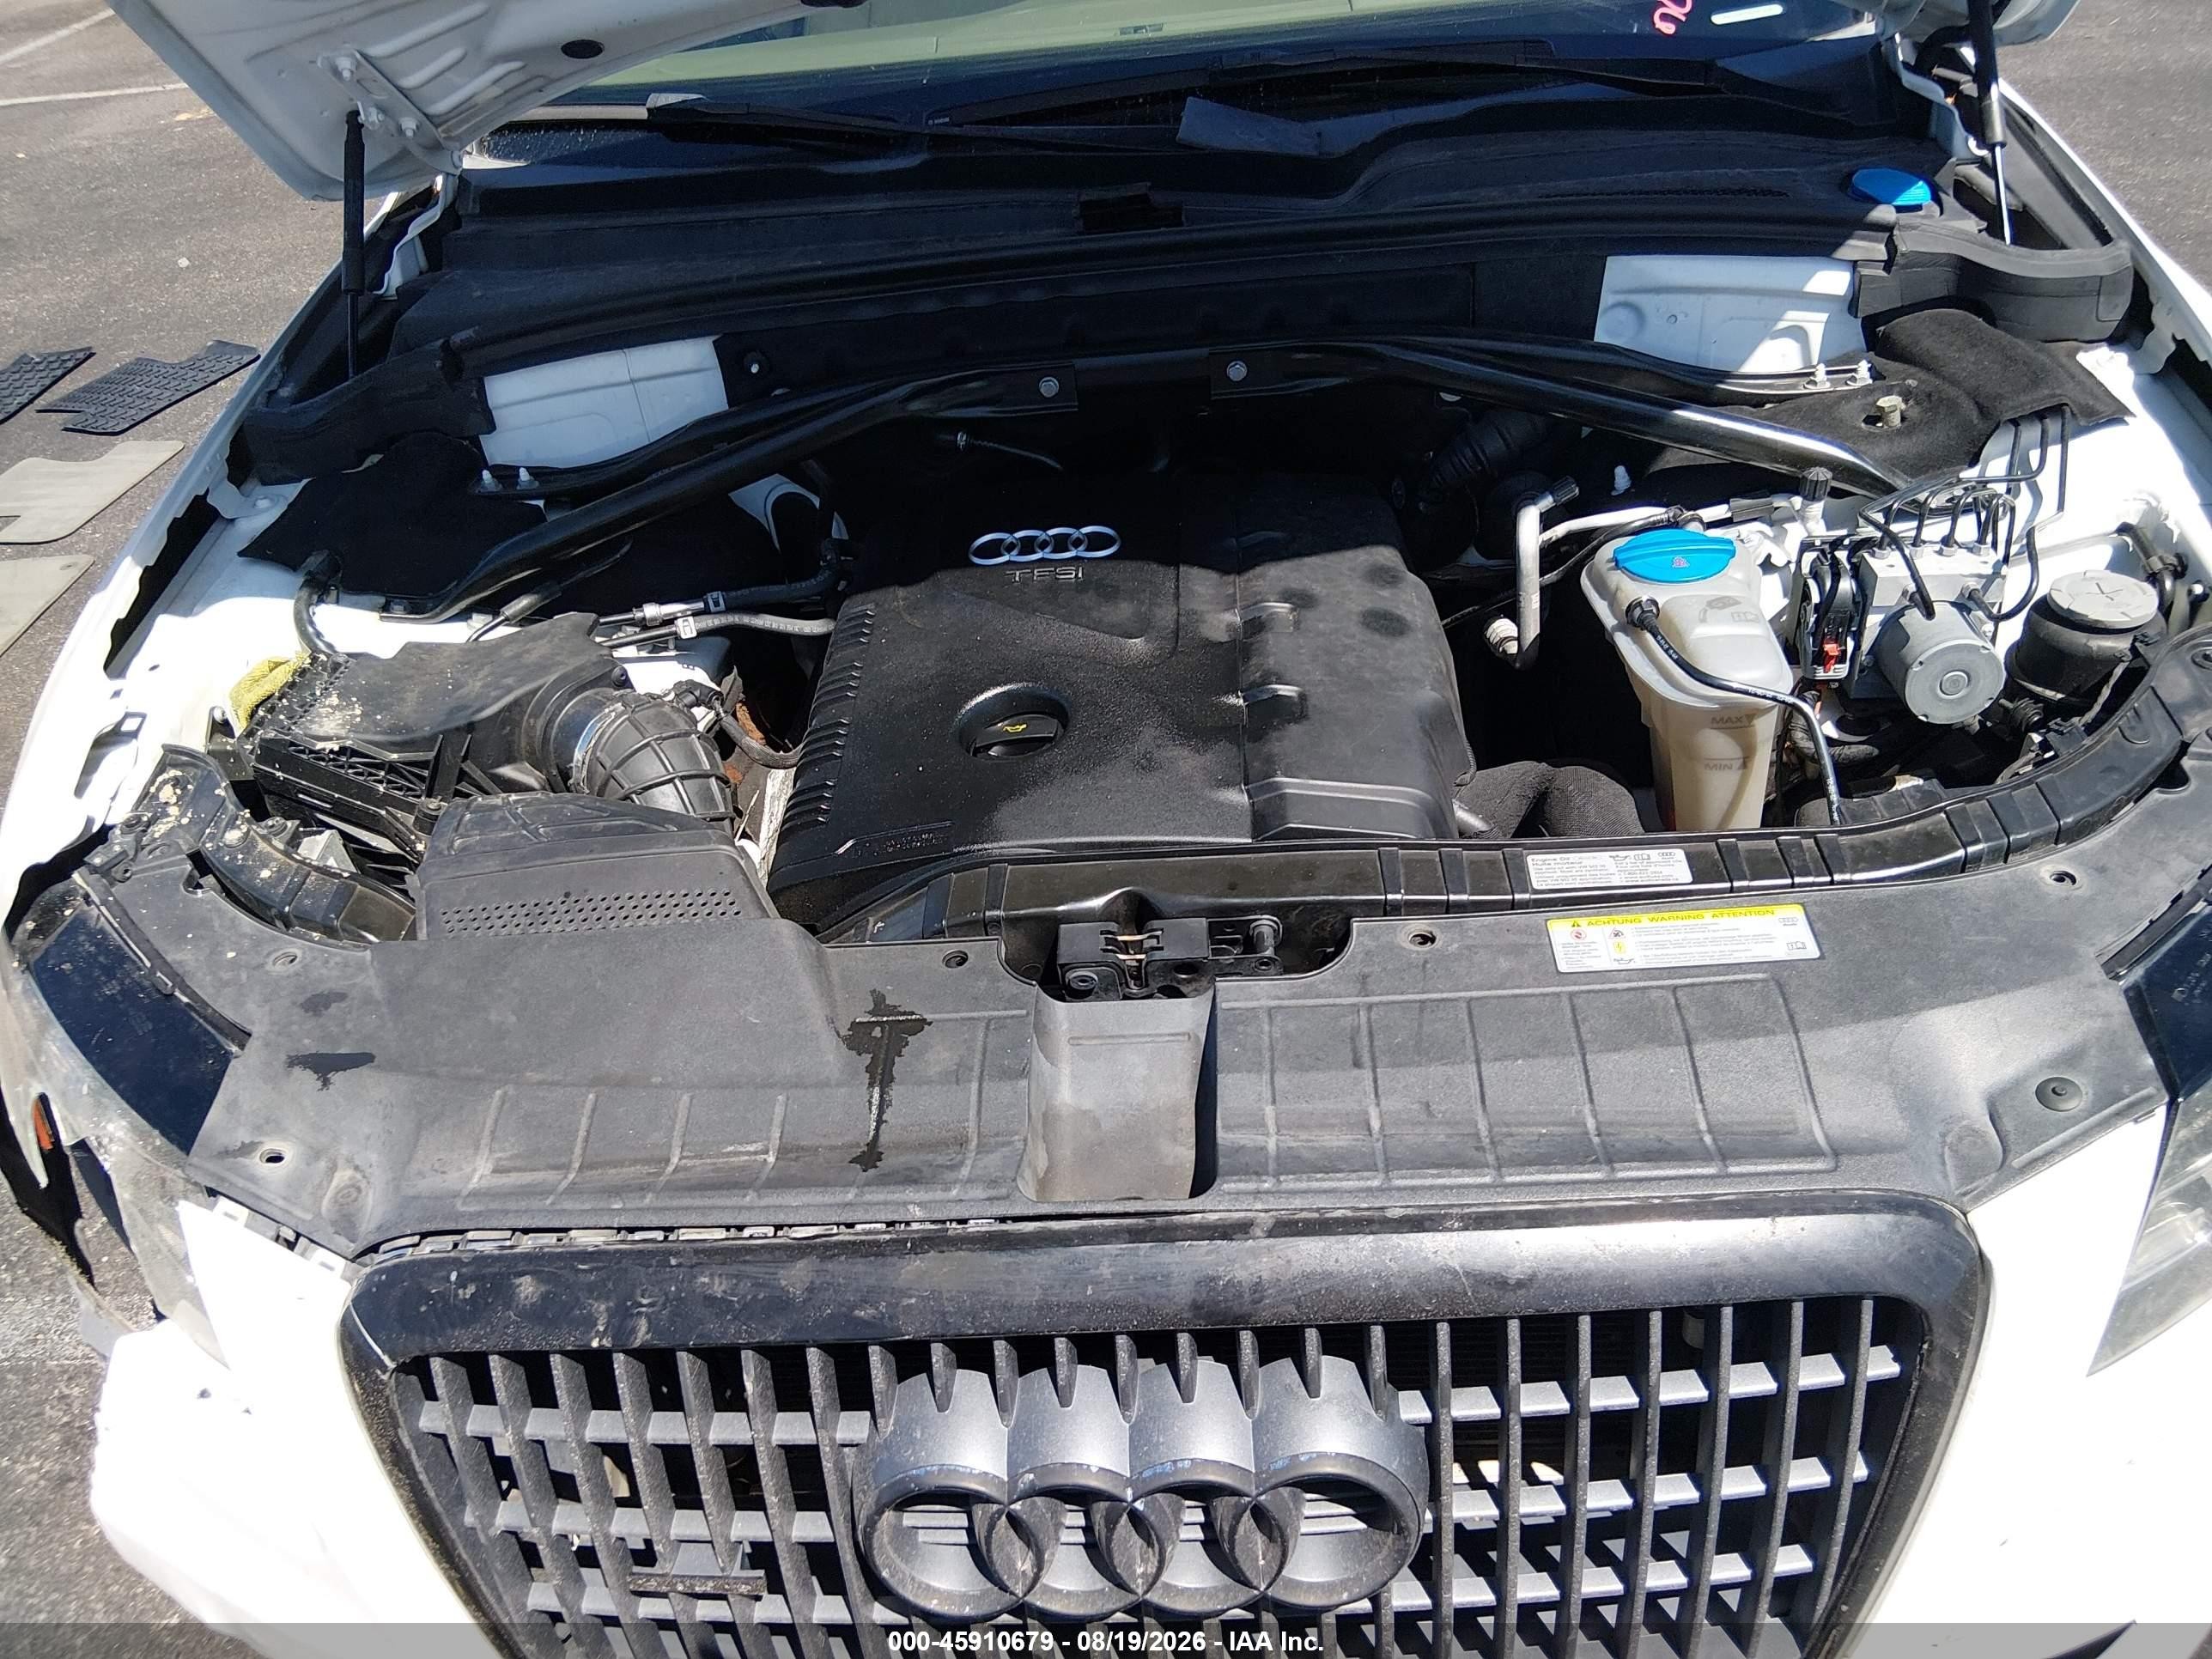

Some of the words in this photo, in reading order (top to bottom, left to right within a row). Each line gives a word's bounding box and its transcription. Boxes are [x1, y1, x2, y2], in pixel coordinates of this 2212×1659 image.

[1006, 566, 1084, 582] TFSI
[1711, 715, 1743, 725] MAX
[1587, 917, 1642, 926] ACHTUNG
[1648, 913, 1705, 922] WARNING
[1711, 909, 1775, 919] ATTENTION
